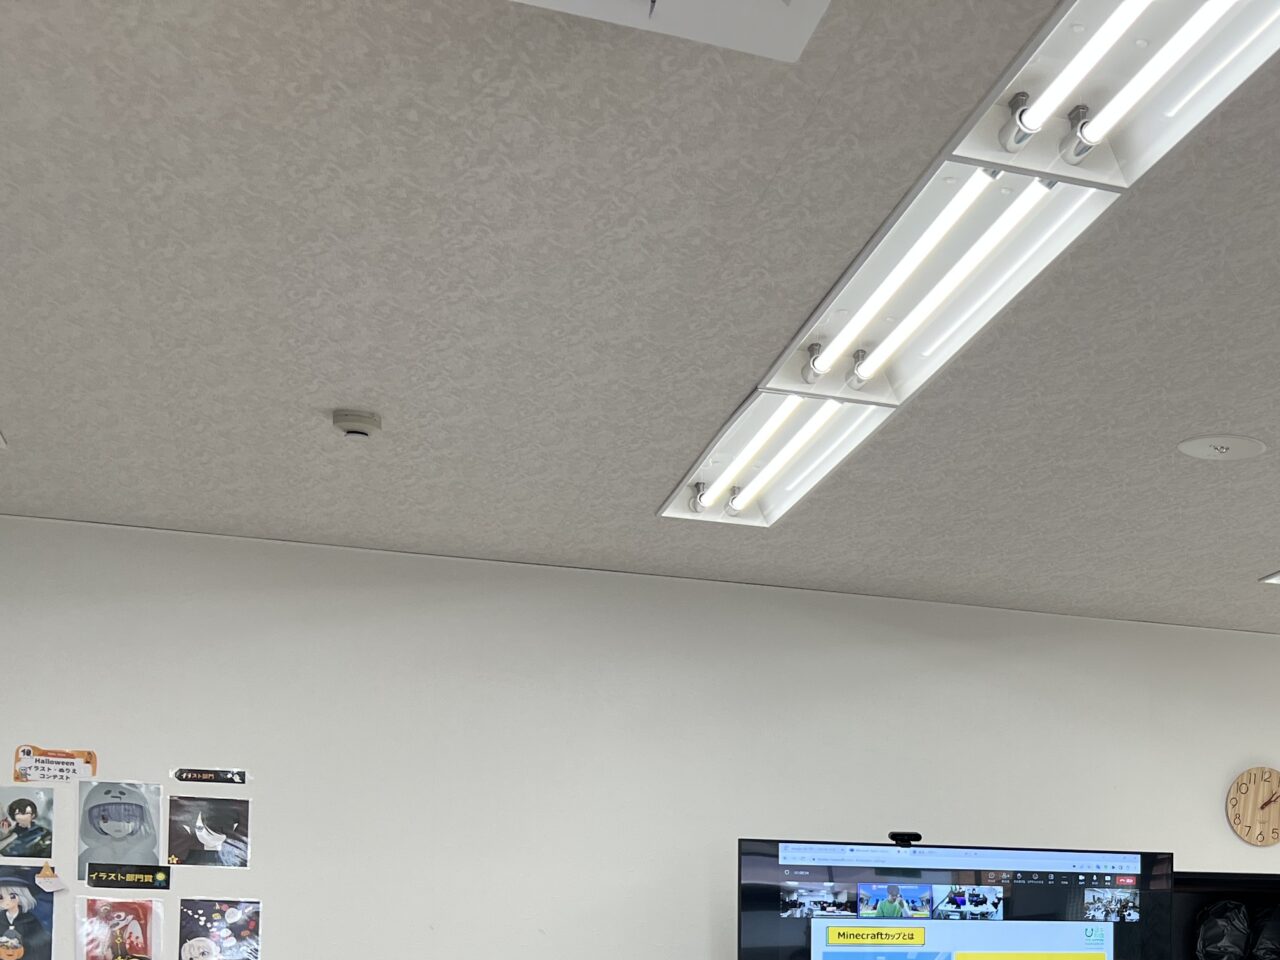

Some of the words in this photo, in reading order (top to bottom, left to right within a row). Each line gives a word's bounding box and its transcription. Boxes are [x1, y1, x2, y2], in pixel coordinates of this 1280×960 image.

[34, 758, 75, 766] Halloween
[1248, 772, 1257, 785] 11
[1261, 770, 1272, 783] 12
[1236, 782, 1249, 795] 10
[1229, 797, 1239, 809] 9
[1233, 813, 1242, 826] 8
[1244, 825, 1252, 837] 7
[1256, 830, 1265, 843] 6
[1271, 828, 1280, 840] 5
[89, 872, 153, 882] イラスト部門賞
[837, 931, 915, 941] Minecraftカップとは
